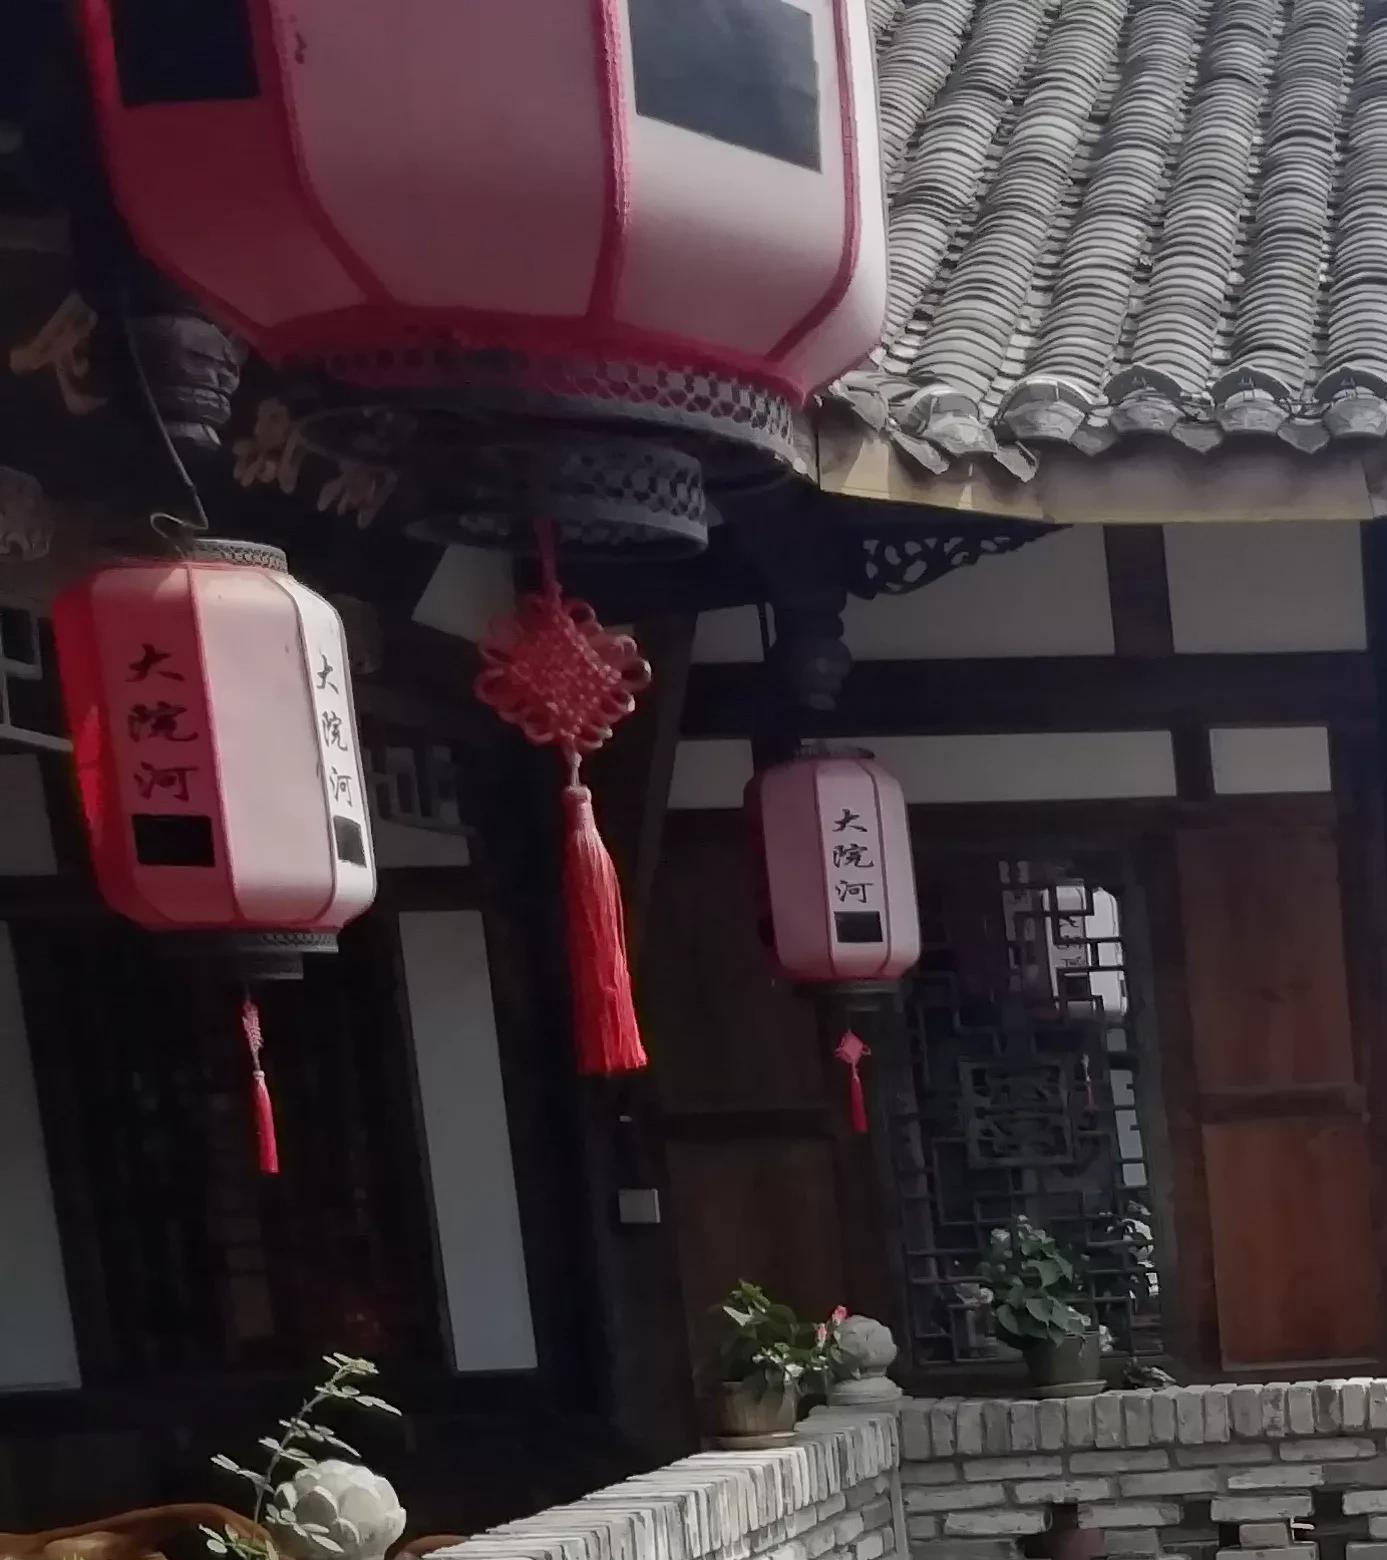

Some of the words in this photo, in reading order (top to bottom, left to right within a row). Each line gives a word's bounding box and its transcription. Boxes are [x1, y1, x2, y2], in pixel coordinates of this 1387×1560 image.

[126, 643, 199, 802] 大院河
[316, 653, 354, 808] 大院河
[832, 808, 874, 904] 大院河
